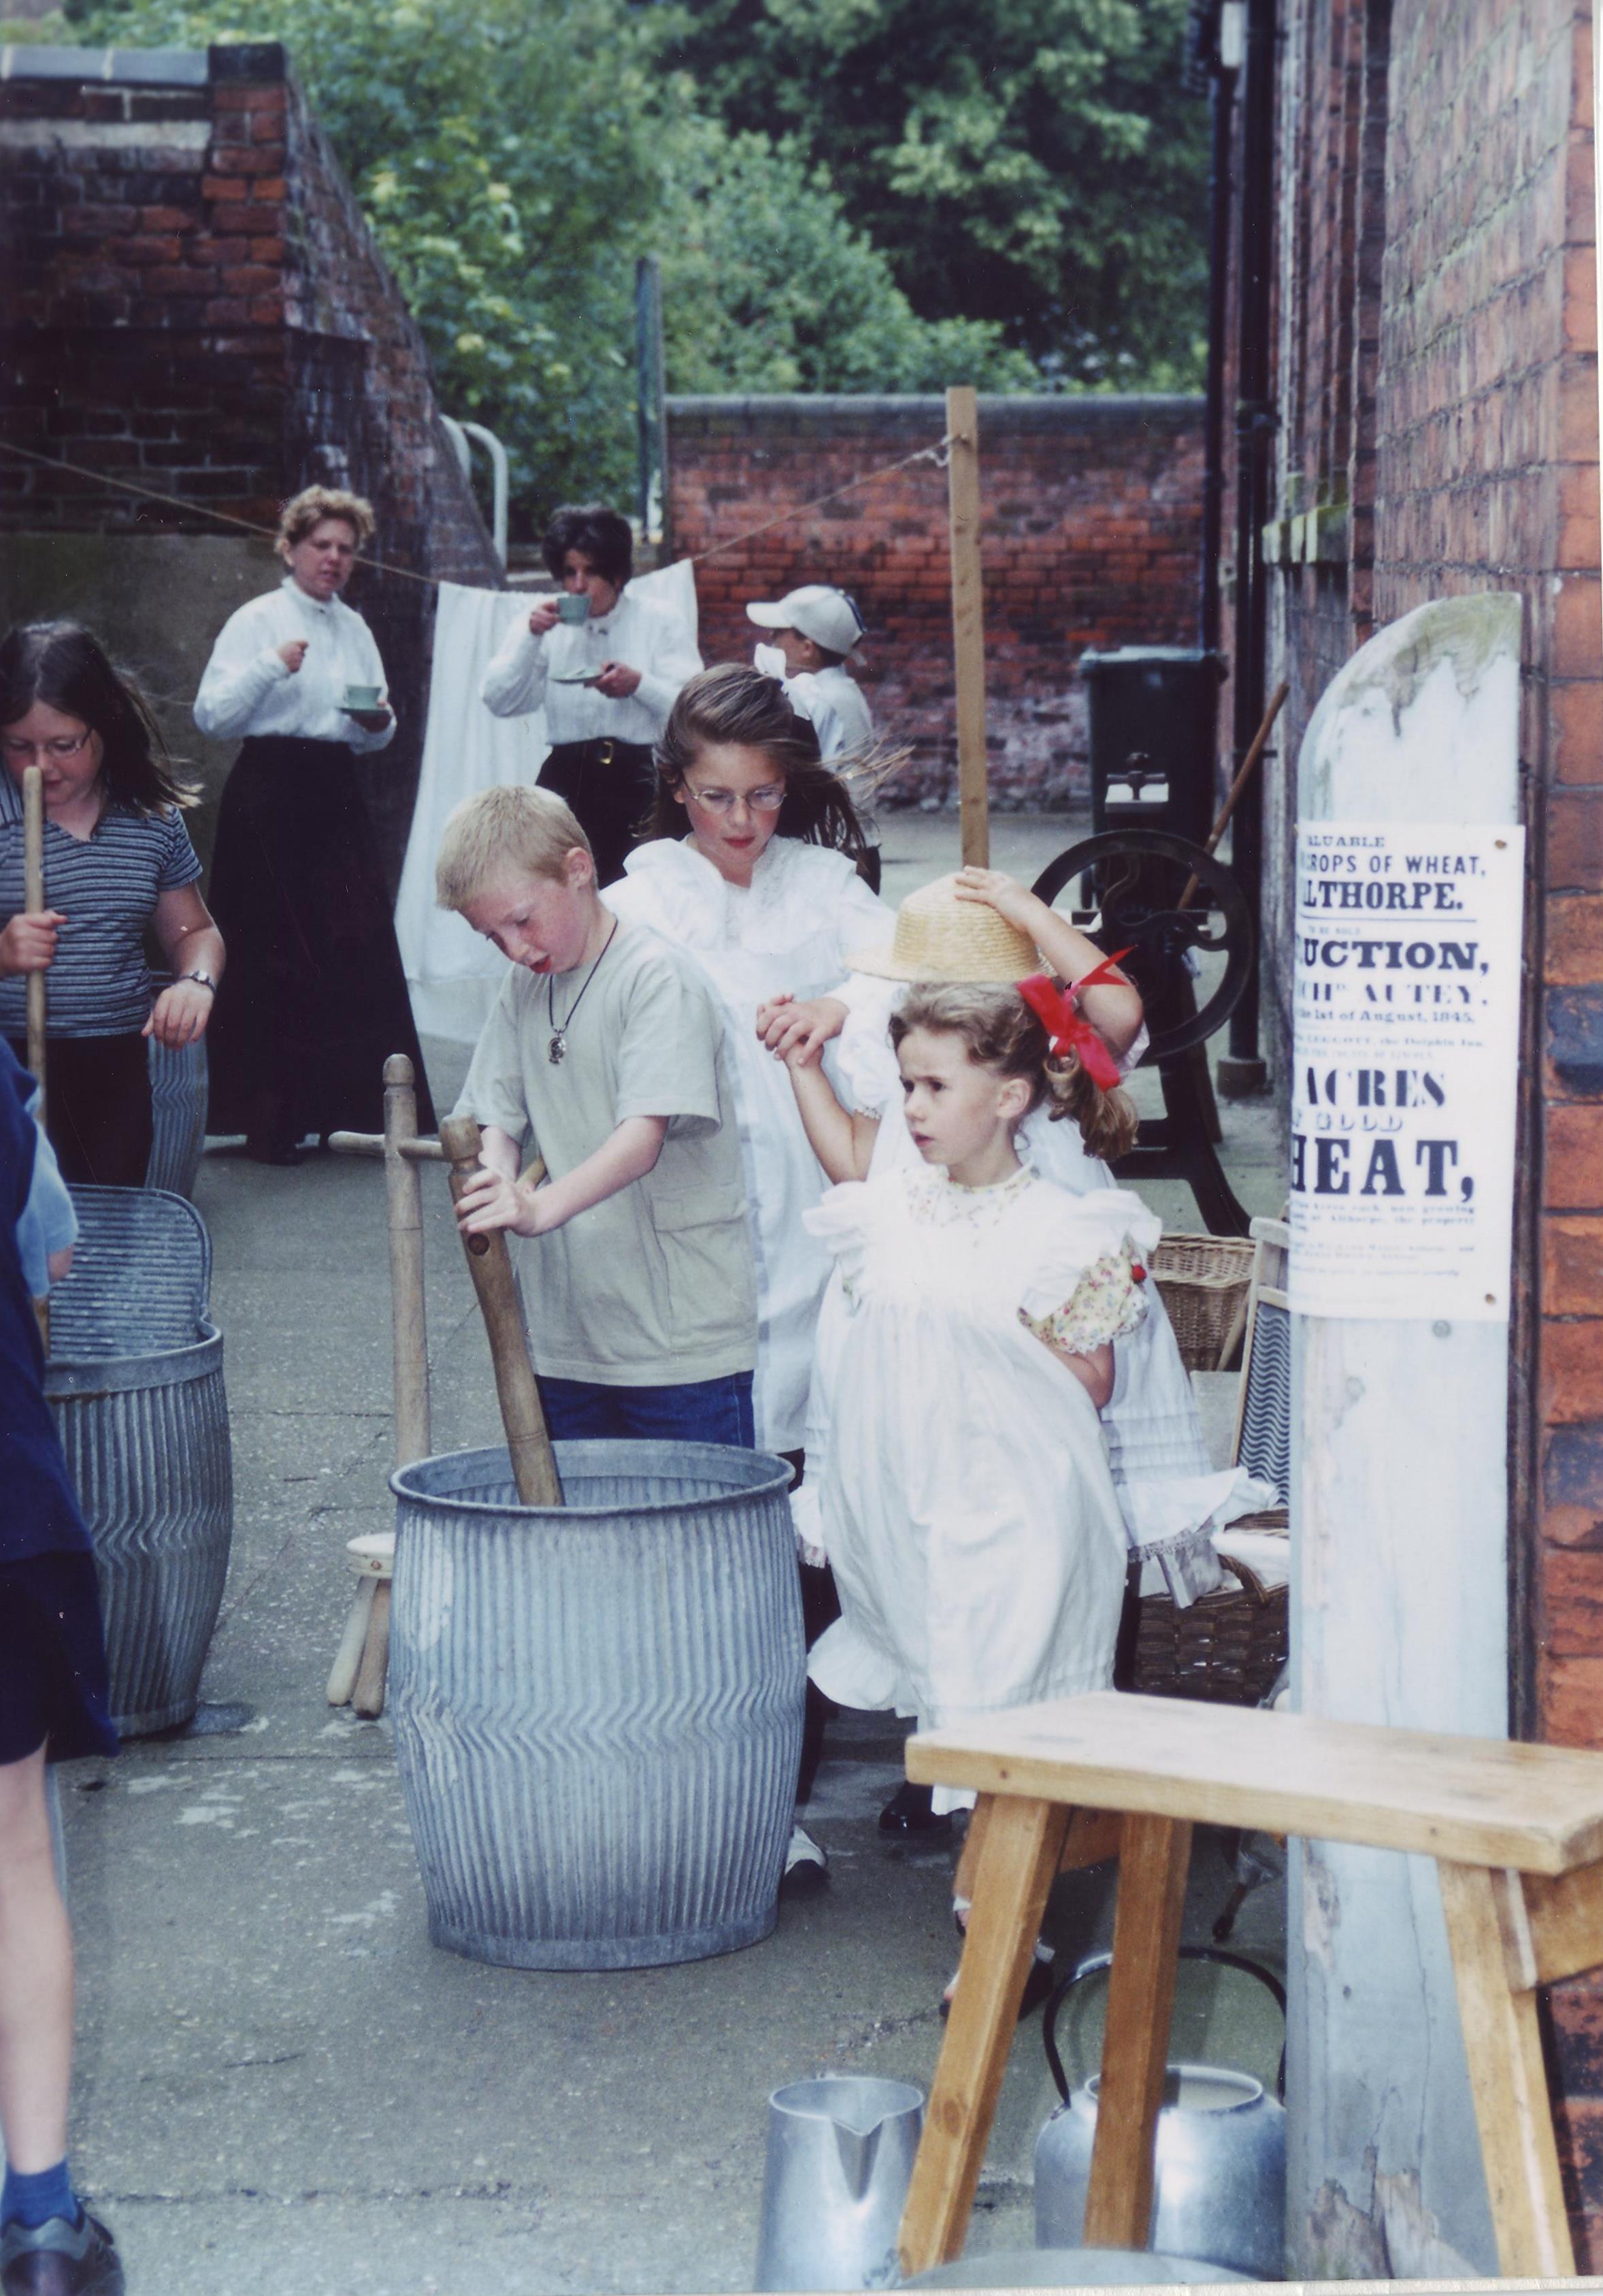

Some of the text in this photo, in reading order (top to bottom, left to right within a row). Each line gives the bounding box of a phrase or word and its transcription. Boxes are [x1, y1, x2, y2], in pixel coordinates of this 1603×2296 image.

[1300, 851, 1486, 876] ROPS OF WHEAT,
[1302, 879, 1464, 910] LTHORPE.
[1295, 936, 1489, 976] UCTION,
[1339, 1011, 1355, 1021] of
